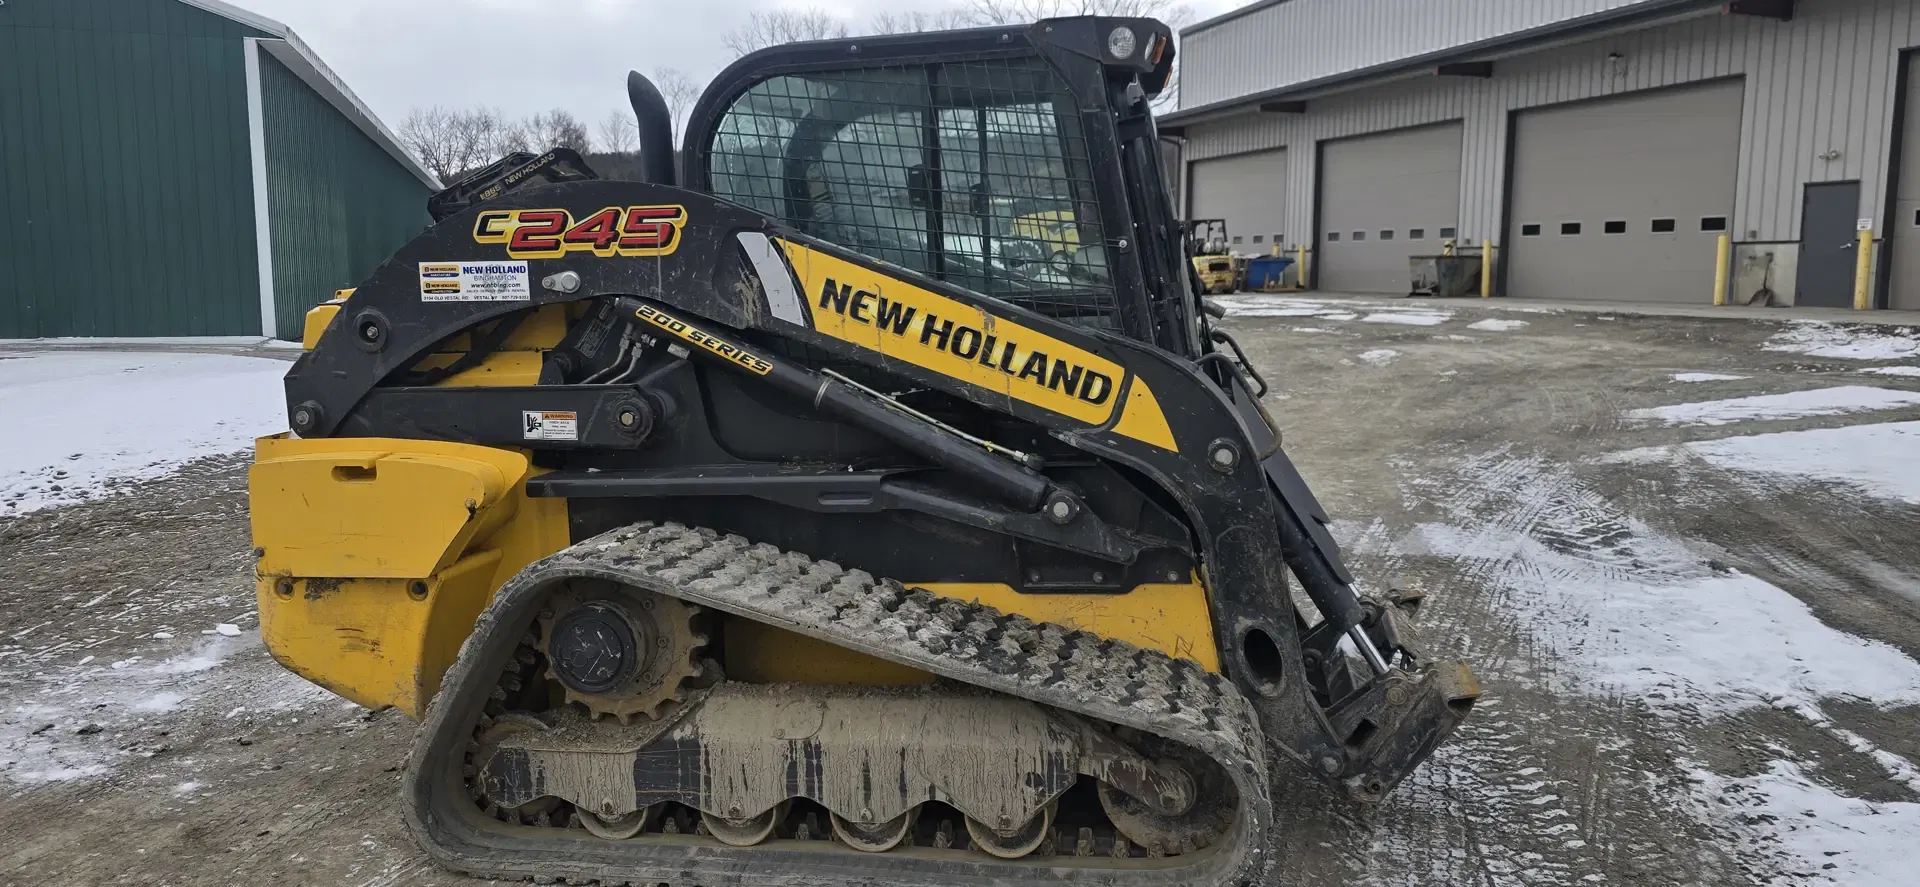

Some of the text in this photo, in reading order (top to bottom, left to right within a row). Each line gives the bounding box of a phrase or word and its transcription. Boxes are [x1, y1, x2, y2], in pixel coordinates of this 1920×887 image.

[505, 153, 556, 185] NEW HOLLAND
[462, 265, 526, 274] NEW HOLLAND
[638, 305, 687, 333] 200
[688, 330, 771, 372] SERIES
[818, 277, 1112, 406] NEW HOLLAND
